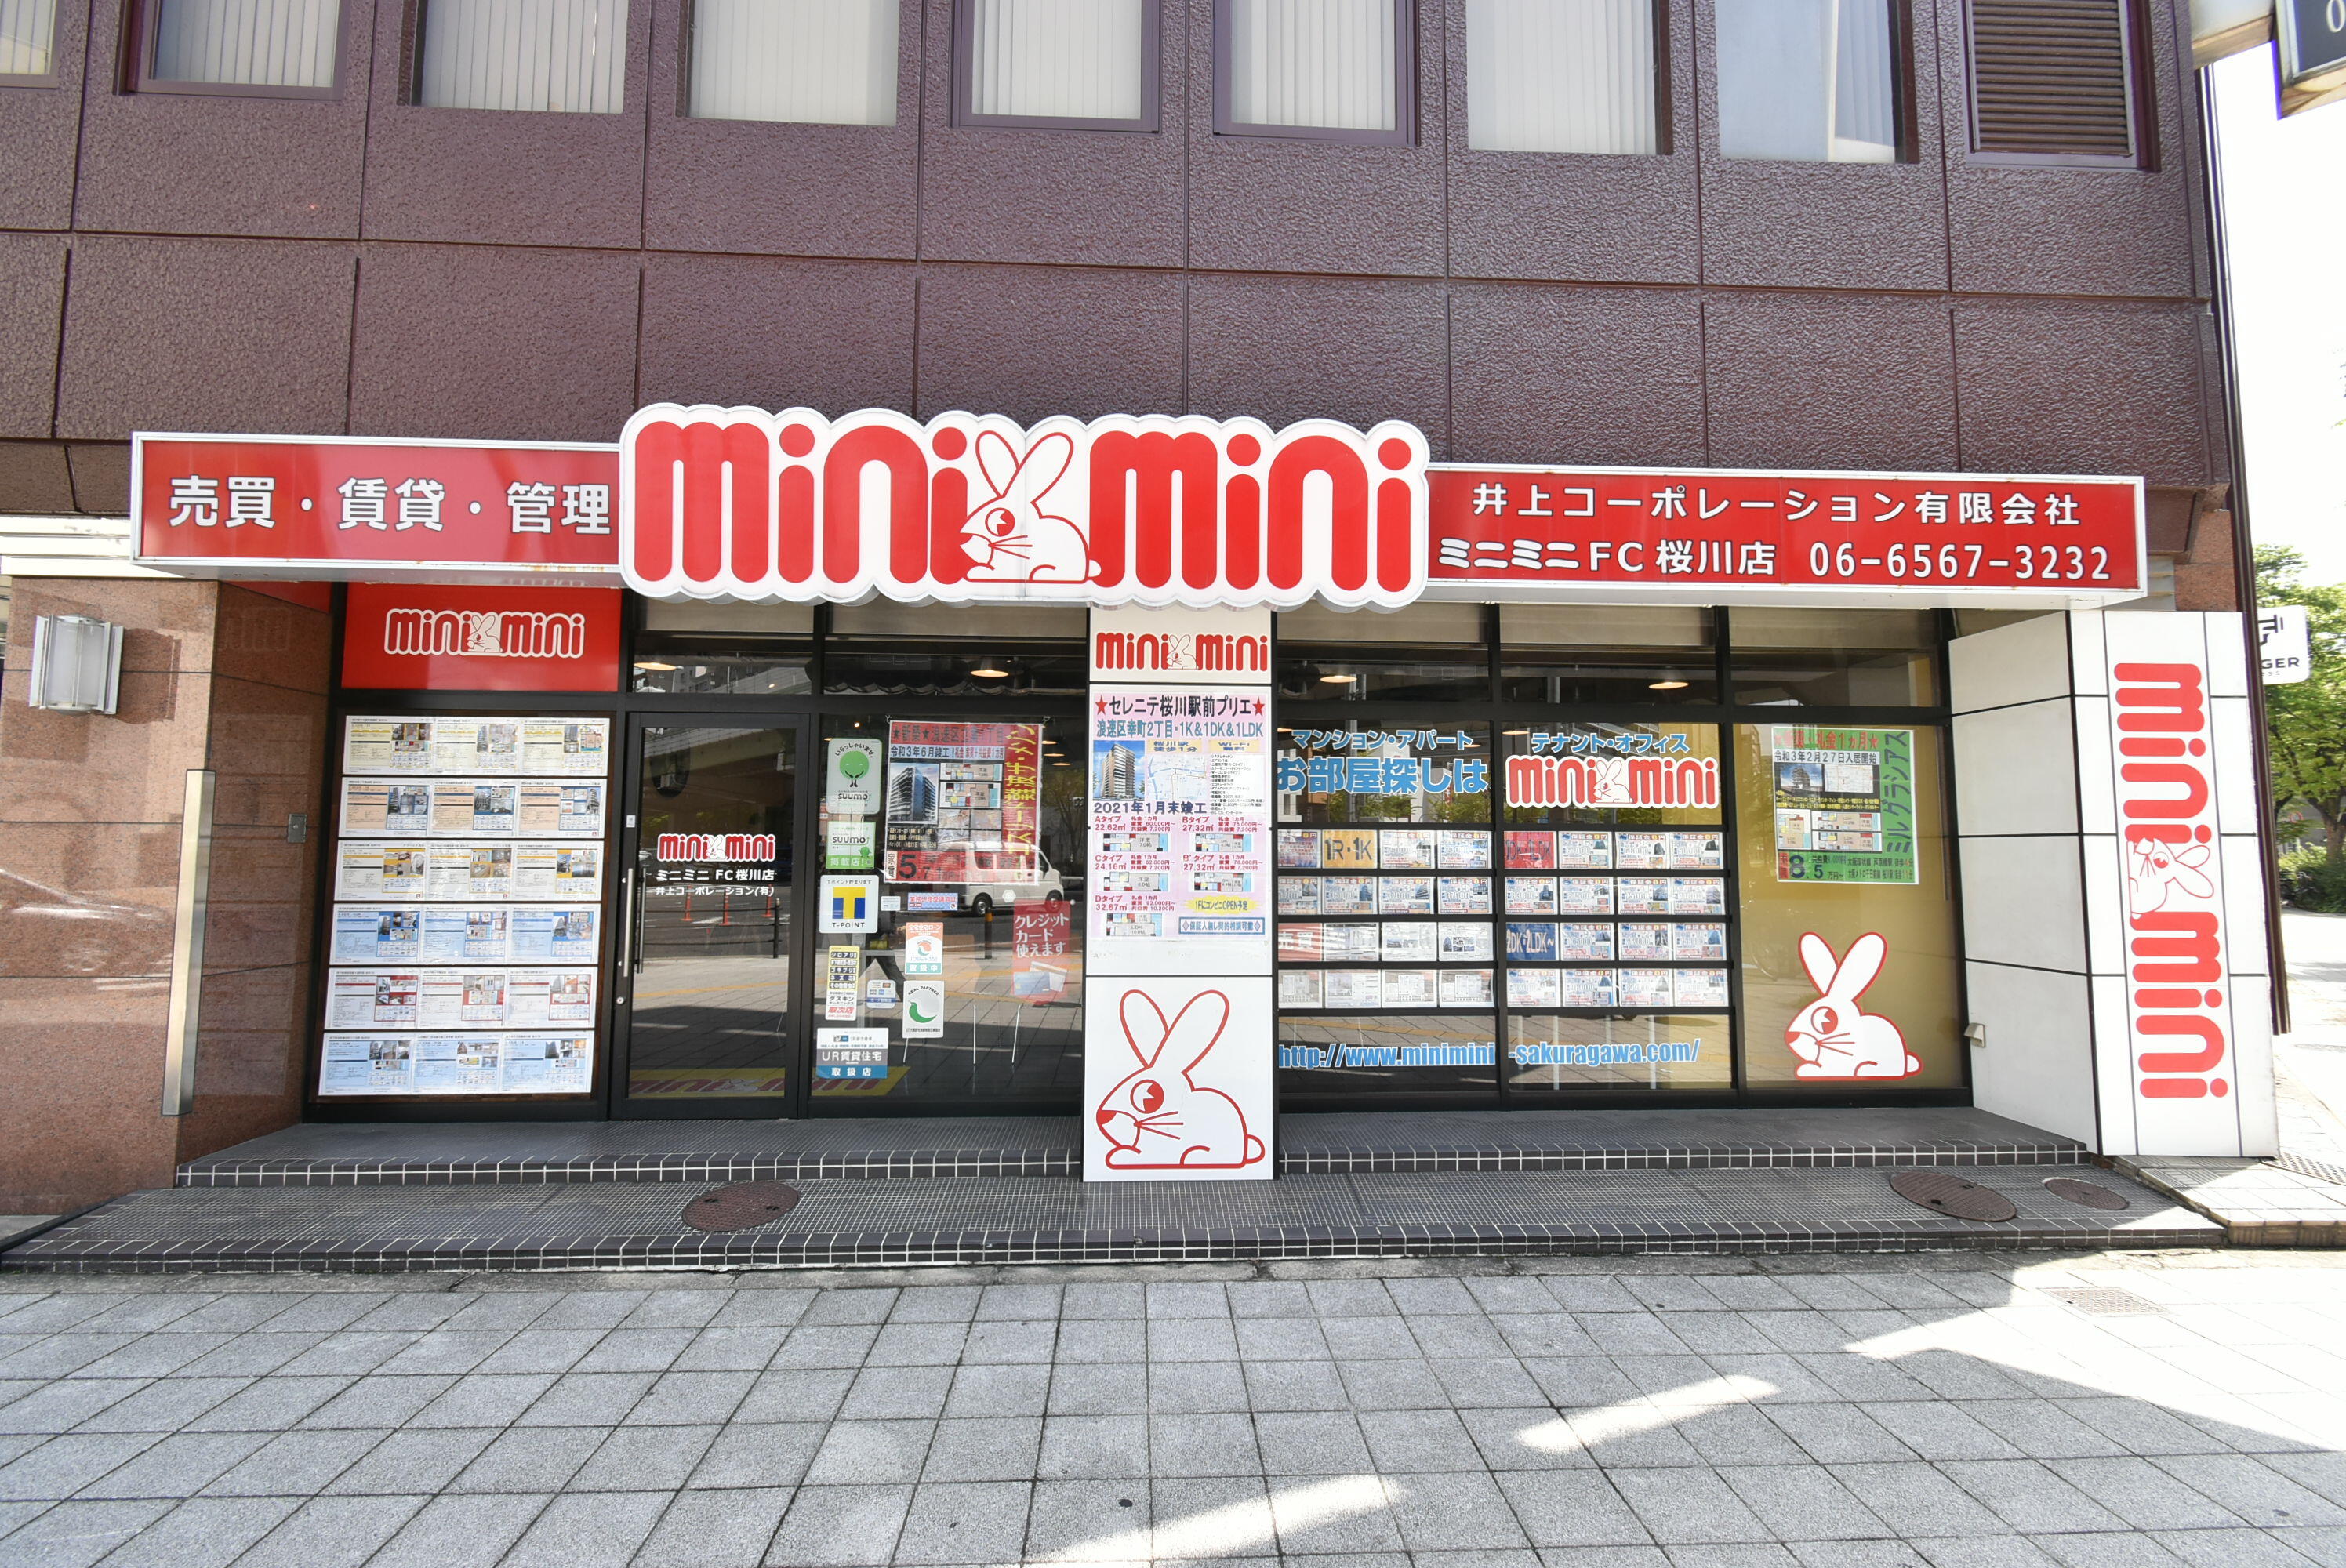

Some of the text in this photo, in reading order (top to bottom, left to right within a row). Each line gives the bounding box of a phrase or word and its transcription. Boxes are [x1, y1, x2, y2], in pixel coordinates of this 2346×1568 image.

[634, 420, 1411, 592] mini mini
[1472, 482, 2082, 528] 井上コーポレーション有限会社
[1810, 541, 2111, 582] 06-6567-3232
[389, 612, 583, 657] mini mini
[1096, 632, 1268, 672] mini mini
[1108, 695, 1251, 717] セレニテ桜川駅前プリエ
[1291, 729, 1474, 751] マンション・アパート
[1531, 732, 1690, 753] テナント・オフィス
[1277, 756, 1489, 794] お部屋探しは
[1509, 757, 1716, 805] mini mini
[1883, 731, 1912, 853] ミルグラシアス
[1093, 801, 1207, 815] 2021年1月末竣工
[659, 835, 775, 861] mini mini
[656, 886, 775, 897] 井上コーポレーション(有)
[2114, 663, 2228, 1098] mini mini
[1015, 913, 1070, 929] クレジット
[1015, 928, 1054, 943] カード
[1015, 942, 1066, 958] 使えます
[921, 985, 939, 996] PARTNER
[822, 1051, 882, 1062] UR賃貸住宅
[831, 1067, 872, 1076] 取扱店
